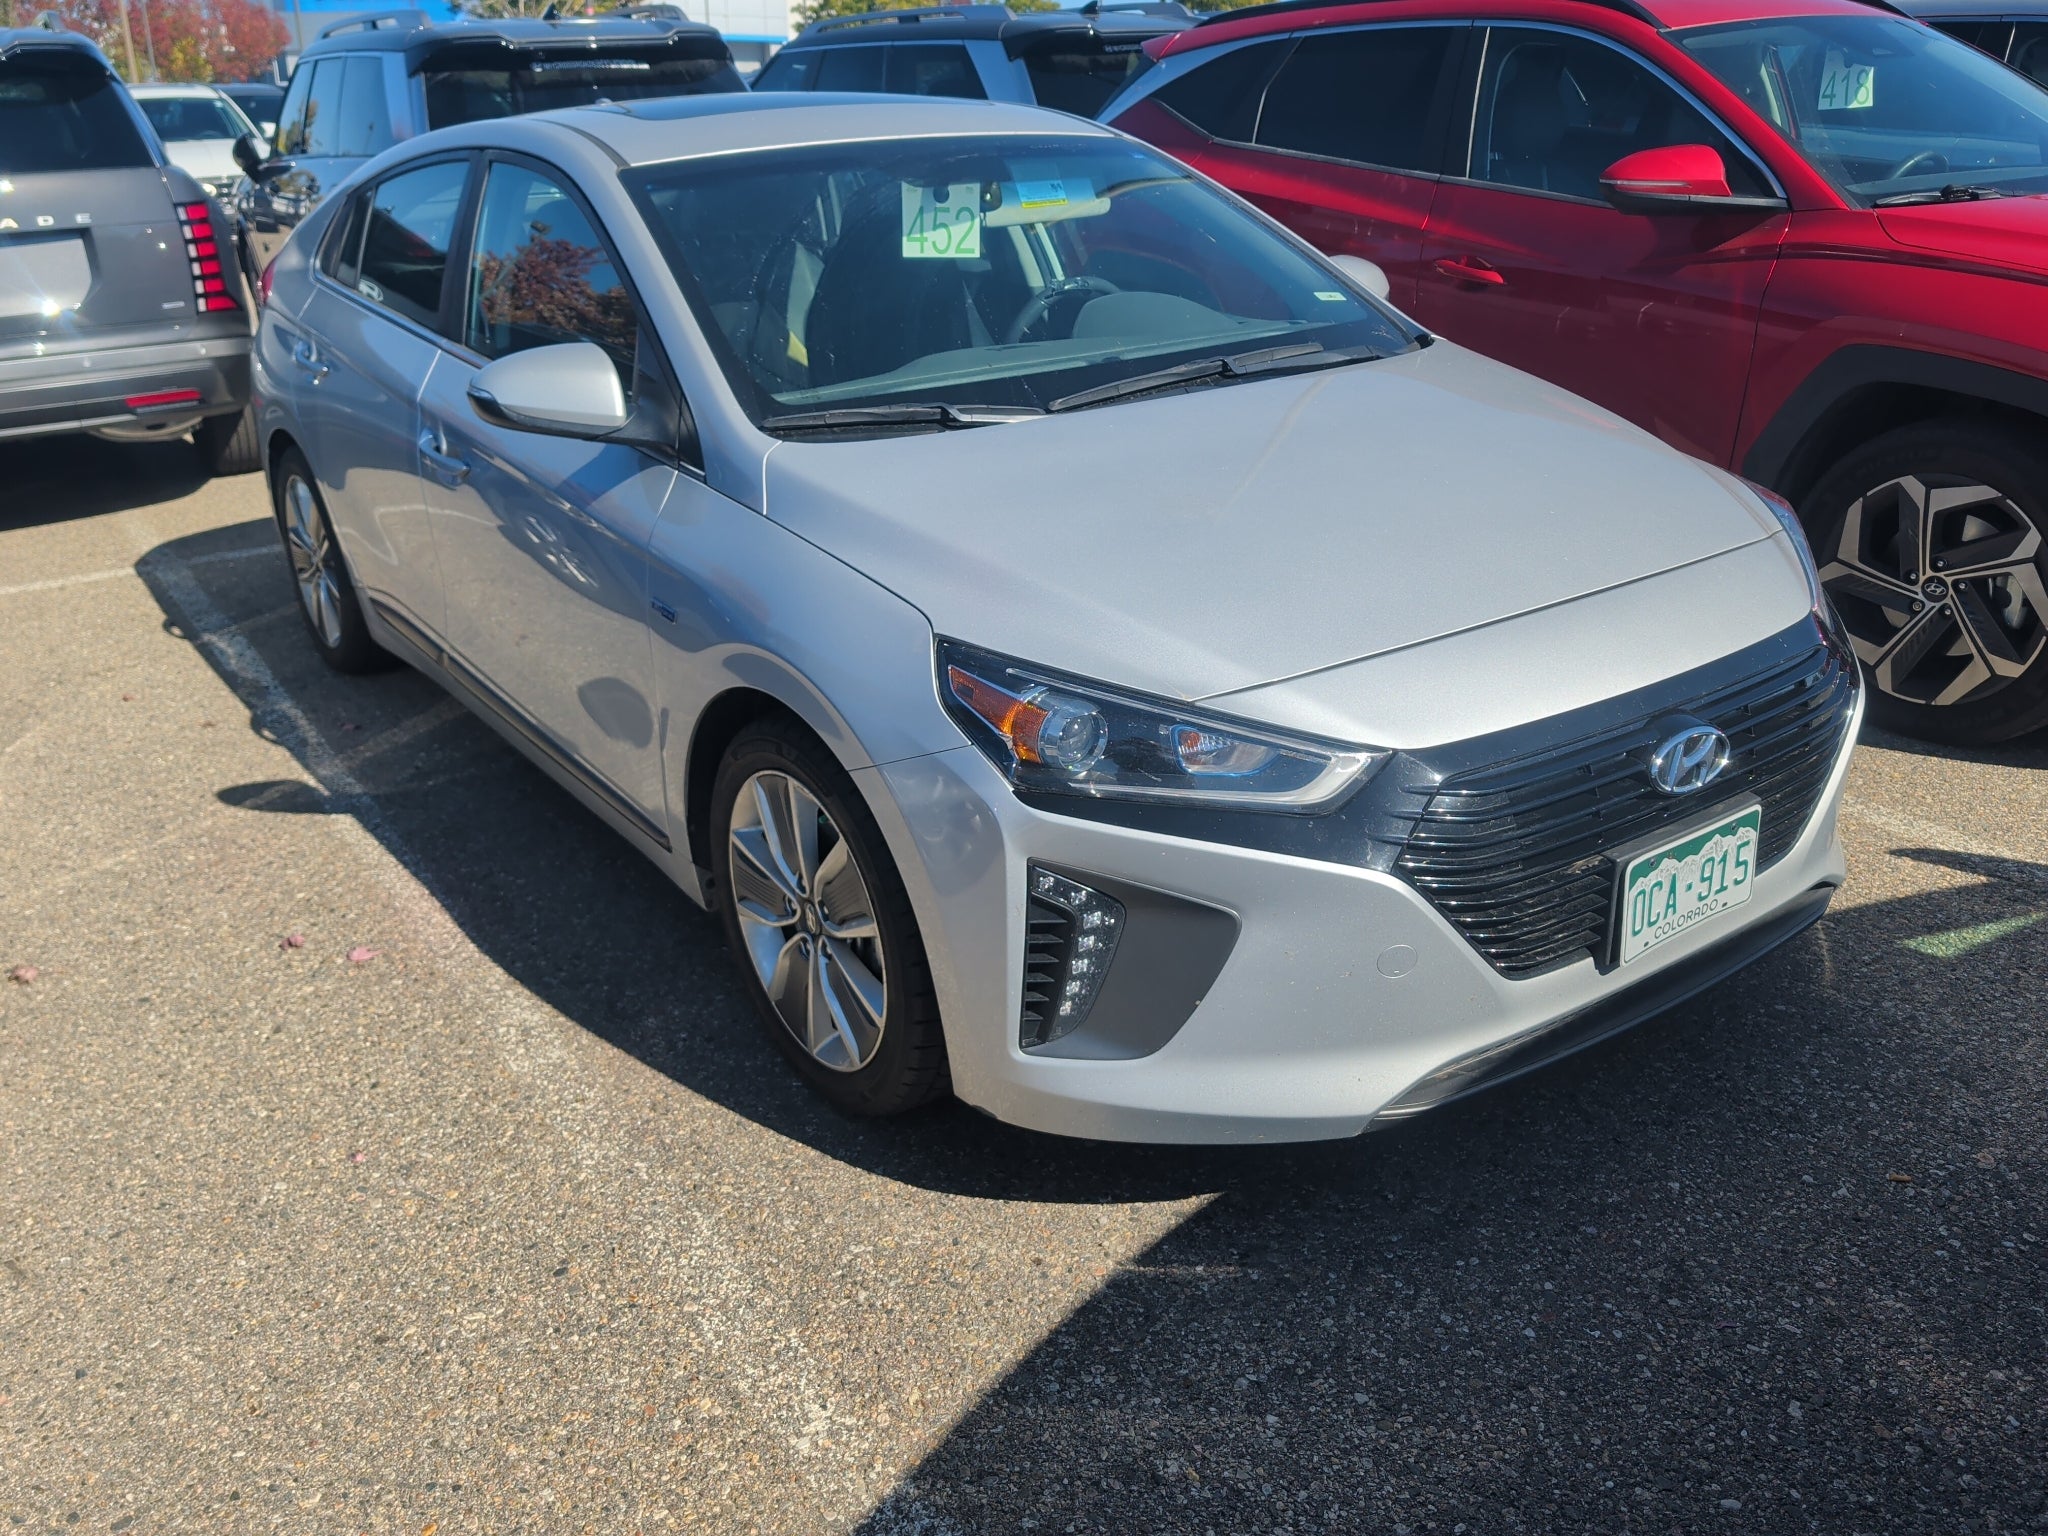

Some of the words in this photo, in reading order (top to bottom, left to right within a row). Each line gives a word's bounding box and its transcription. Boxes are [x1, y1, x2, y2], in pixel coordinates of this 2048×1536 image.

[1821, 69, 1869, 107] 418
[906, 205, 976, 254] 452
[1653, 898, 1719, 940] COLORADO
